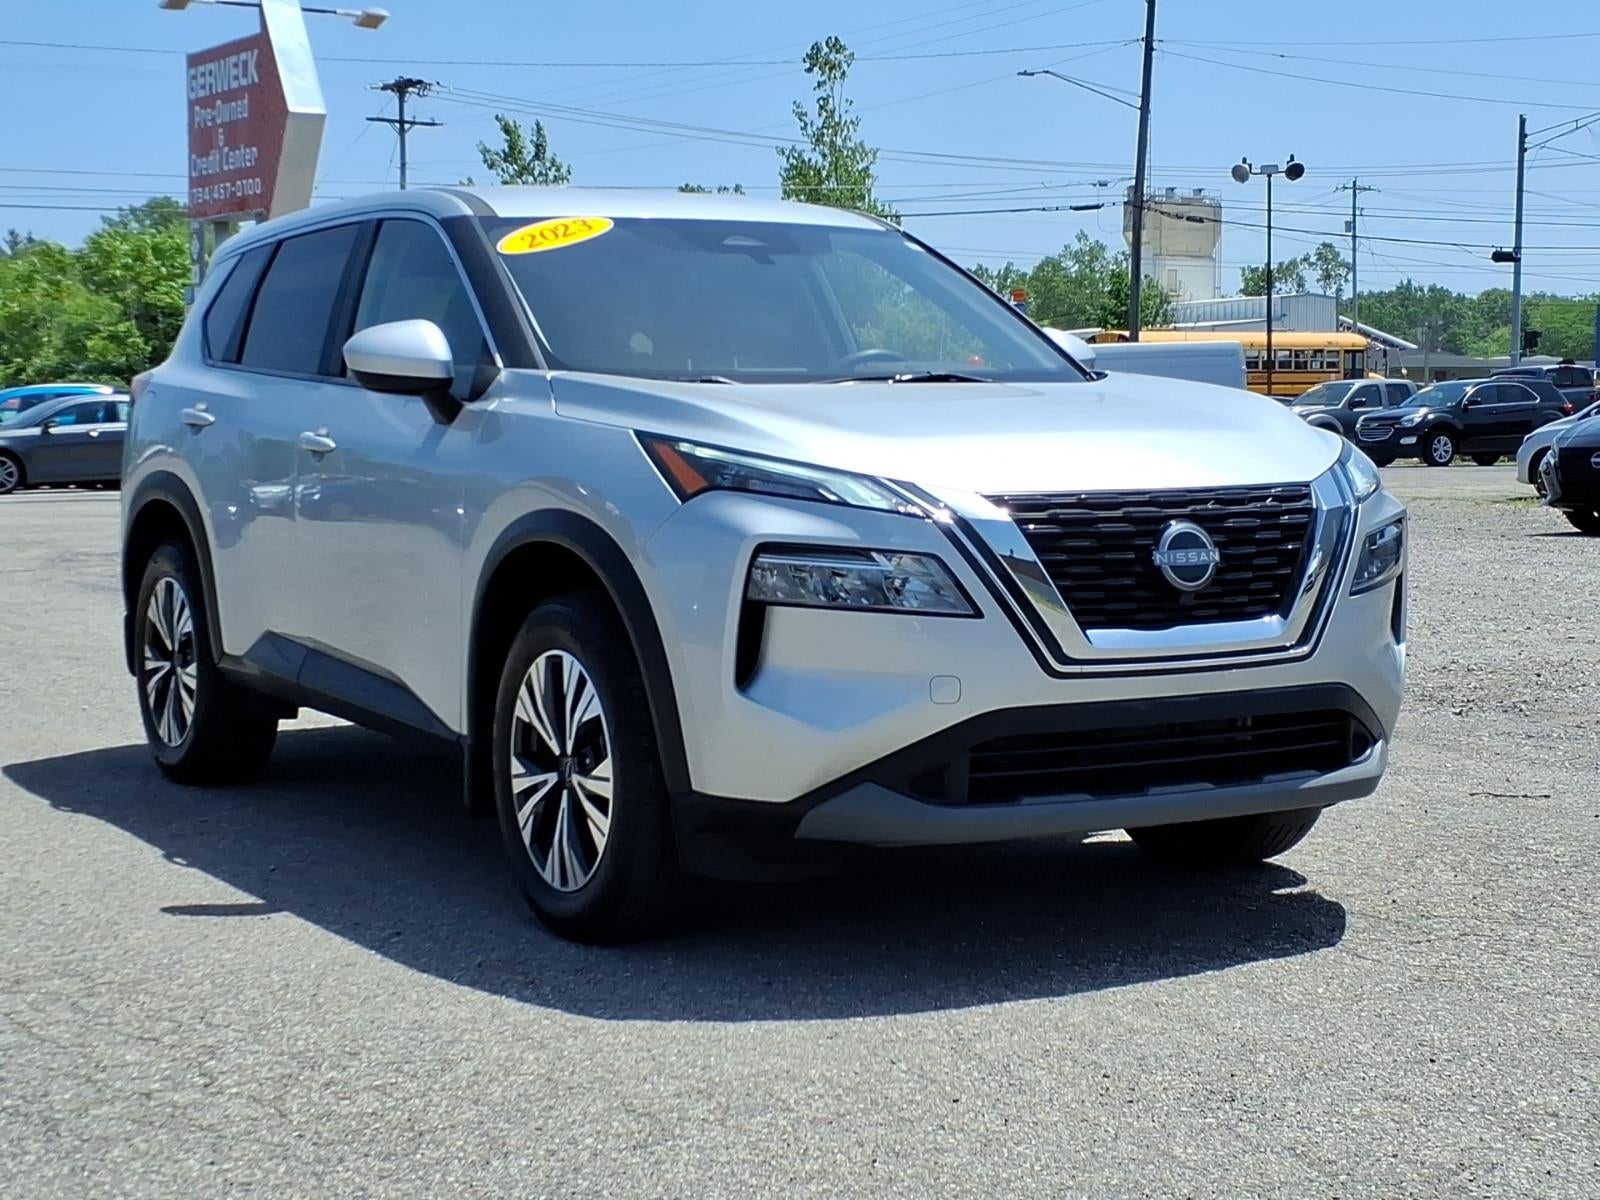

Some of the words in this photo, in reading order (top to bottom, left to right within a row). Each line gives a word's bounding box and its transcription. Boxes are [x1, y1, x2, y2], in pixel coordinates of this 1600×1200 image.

[189, 49, 259, 100] GERWECK
[194, 93, 248, 128] Pre-Owned
[191, 150, 220, 177] Credit
[222, 144, 258, 171] Center
[520, 219, 593, 248] 2023
[1156, 551, 1219, 564] NISSAN
